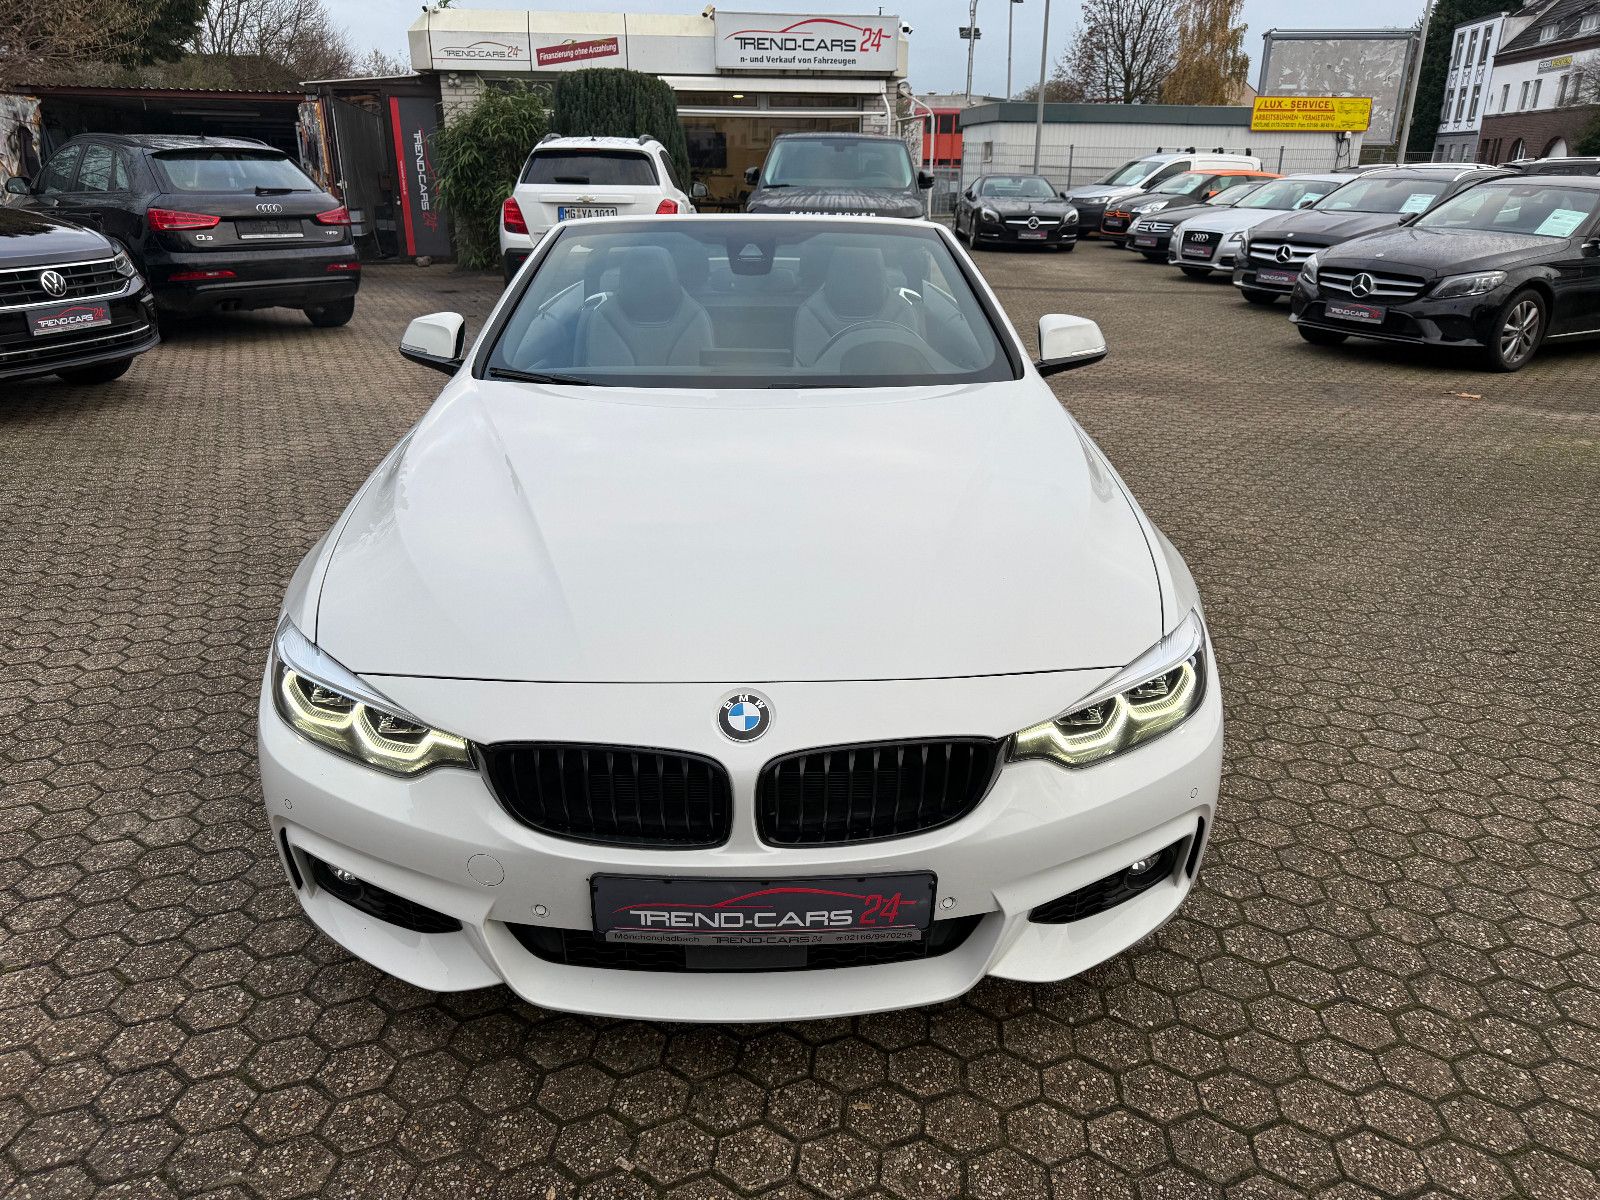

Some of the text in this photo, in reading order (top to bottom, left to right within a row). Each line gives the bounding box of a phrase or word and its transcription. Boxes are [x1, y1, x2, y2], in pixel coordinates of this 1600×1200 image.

[734, 28, 883, 52] TREND-CARS 24
[444, 46, 519, 58] TREND-CARS 24
[540, 43, 617, 60] Finanzierung ohne Anzahlung
[813, 57, 857, 66] Fahrzeugen
[1264, 100, 1283, 109] LUX
[1291, 100, 1330, 109] SERVICE
[413, 129, 430, 211] TREND-CARS
[564, 208, 576, 219] MG
[581, 208, 593, 218] YA
[1330, 307, 1370, 318] TREND-CARS
[37, 313, 94, 328] TREND-CARS
[723, 694, 766, 710] BMW
[629, 892, 902, 928] TREND-CARS 24
[614, 933, 700, 943] Mönchengladbach
[712, 936, 810, 944] TREND-CARS
